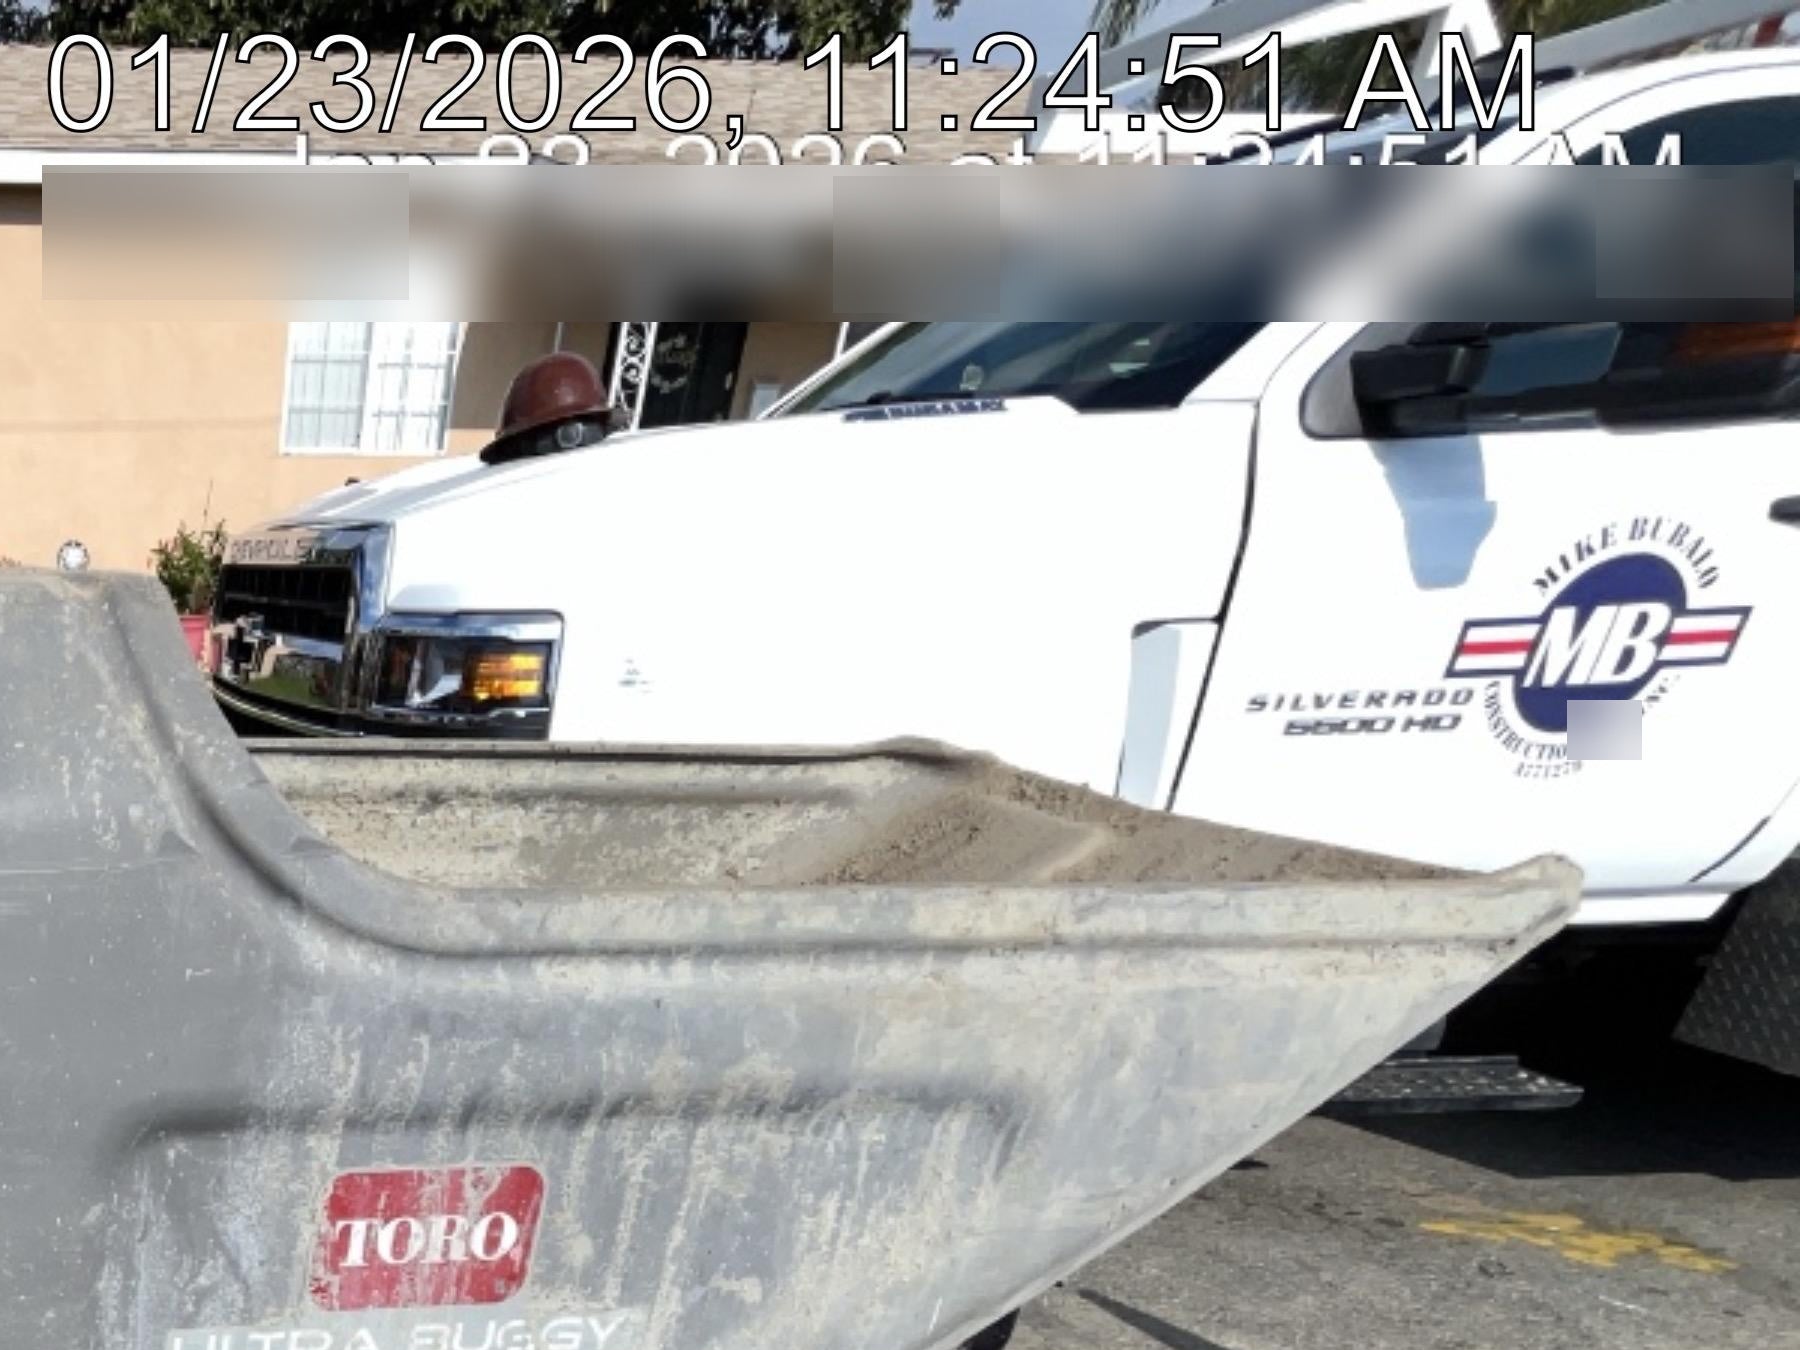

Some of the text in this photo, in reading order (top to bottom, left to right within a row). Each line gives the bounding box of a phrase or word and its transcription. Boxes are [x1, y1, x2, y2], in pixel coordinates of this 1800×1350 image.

[1532, 521, 1618, 597] MIKE
[1522, 602, 1673, 688] MB
[1245, 688, 1474, 712] SILVERADO
[1401, 713, 1463, 732] HD
[1484, 680, 1568, 761] CONSTRUCTIO
[334, 1211, 519, 1268] TORO
